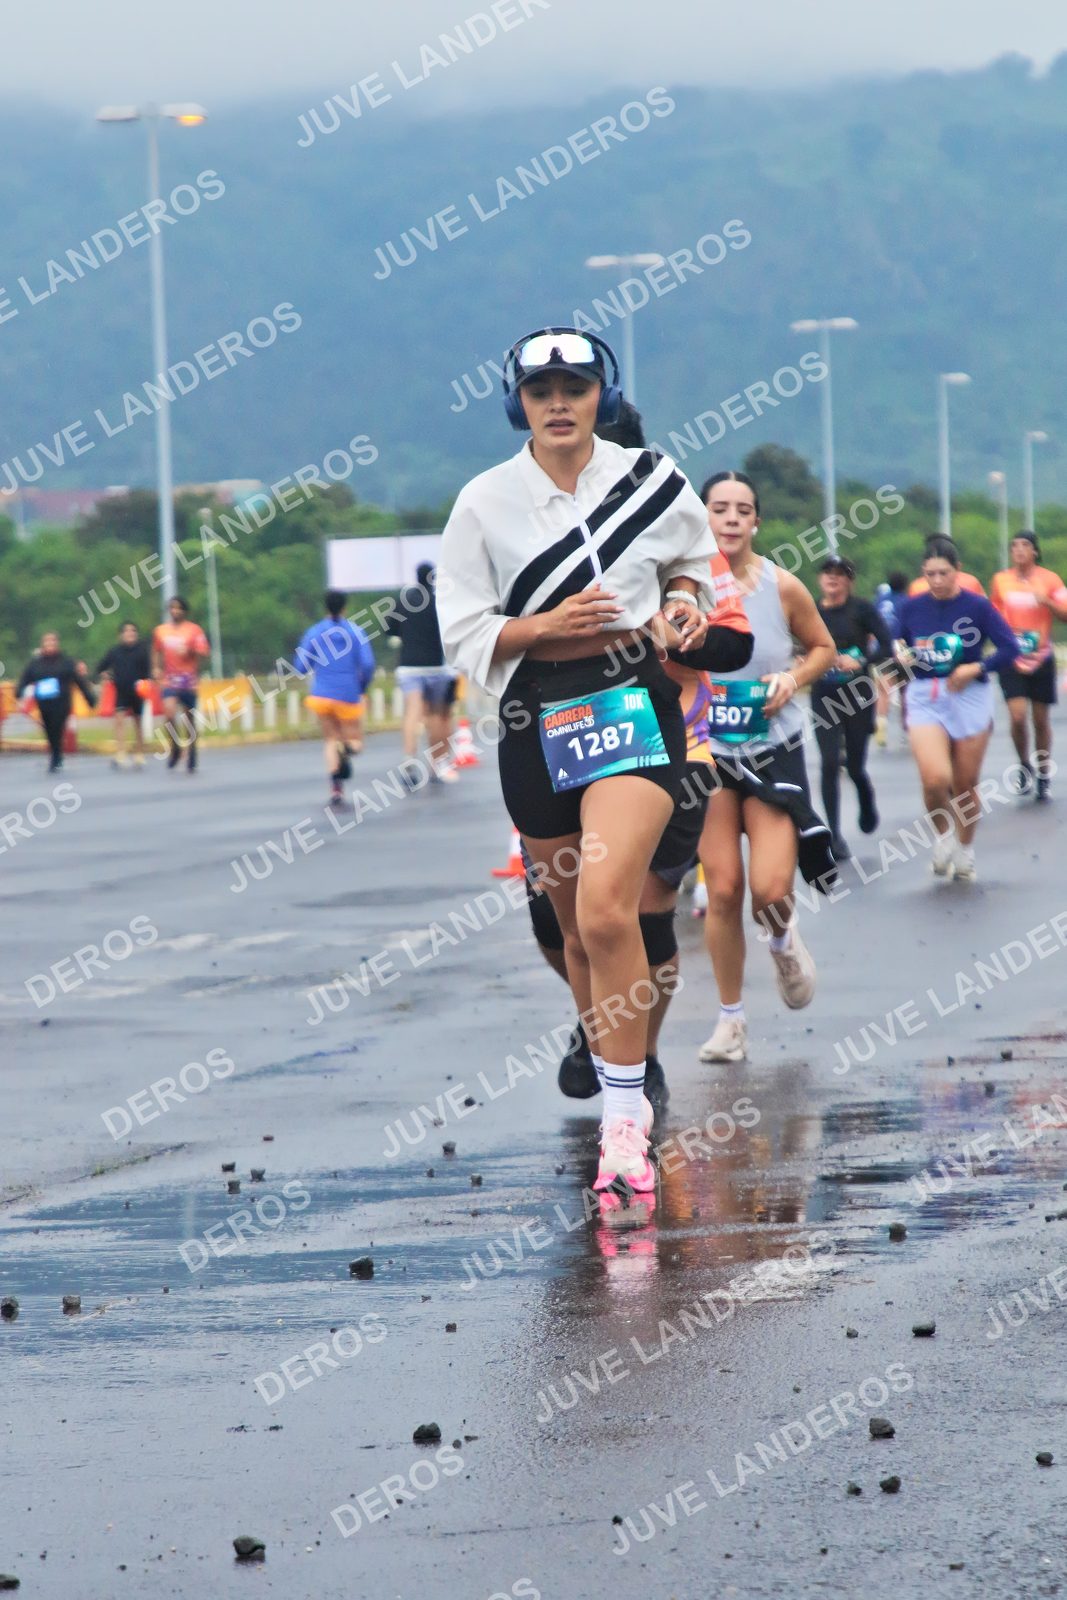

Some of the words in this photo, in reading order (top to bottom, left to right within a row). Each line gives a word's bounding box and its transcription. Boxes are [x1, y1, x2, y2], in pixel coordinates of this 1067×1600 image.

[623, 693, 645, 711] 10K
[544, 704, 593, 731] CARRERA
[707, 705, 753, 726] 1507
[567, 721, 635, 761] 1287
